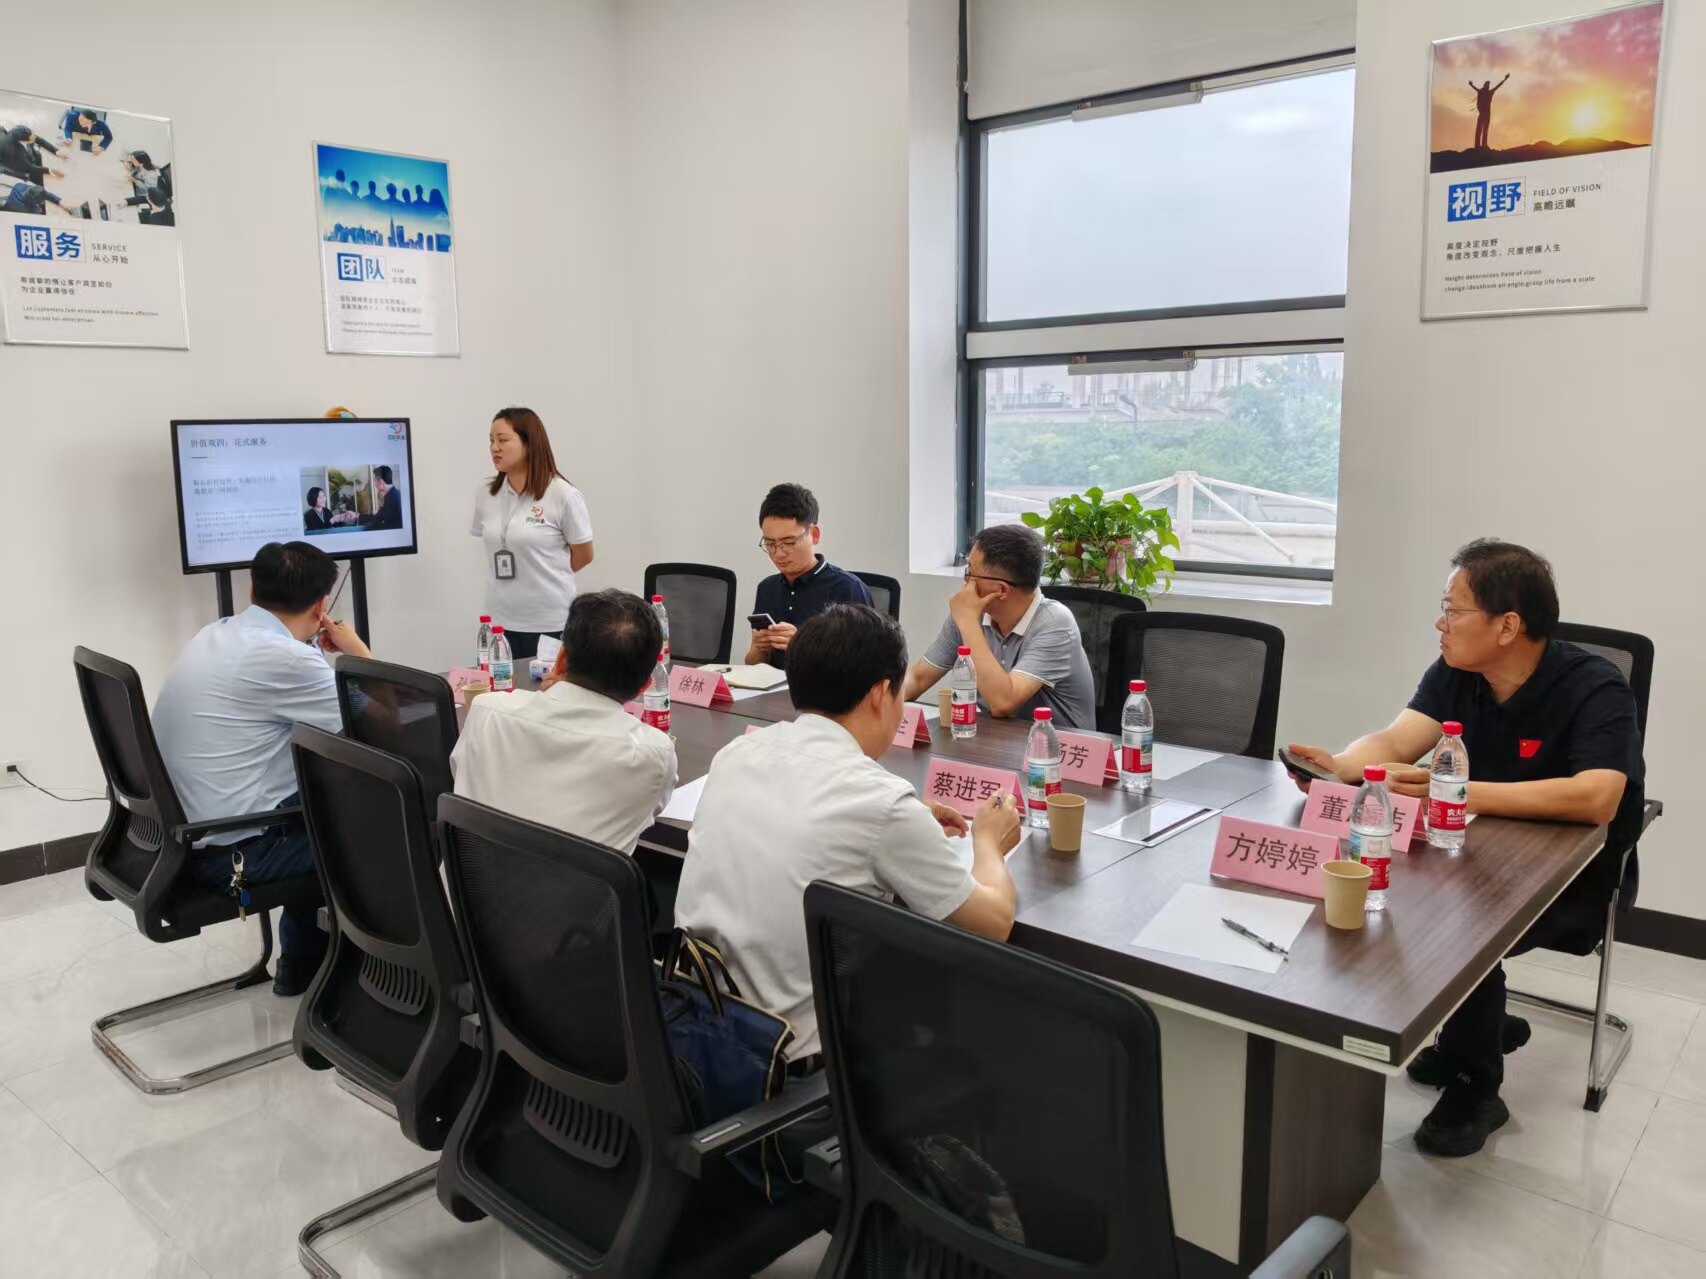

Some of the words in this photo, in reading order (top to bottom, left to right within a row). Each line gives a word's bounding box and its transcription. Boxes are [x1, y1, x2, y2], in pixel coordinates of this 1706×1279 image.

[1451, 182, 1522, 218] 视野
[1533, 187, 1556, 197] FIELD
[1558, 186, 1570, 194] OF
[1572, 183, 1601, 193] VISION
[1533, 198, 1576, 212] 高瞻远瞩
[20, 229, 81, 258] 服务
[91, 243, 127, 252] SERVICE
[1446, 238, 1498, 250] 高度决定视野
[92, 254, 129, 264] 从心开始
[340, 255, 385, 281] 团队
[678, 675, 705, 695] 徐林
[933, 771, 1002, 802] 蔡进军
[1226, 832, 1321, 876] 方婷婷
